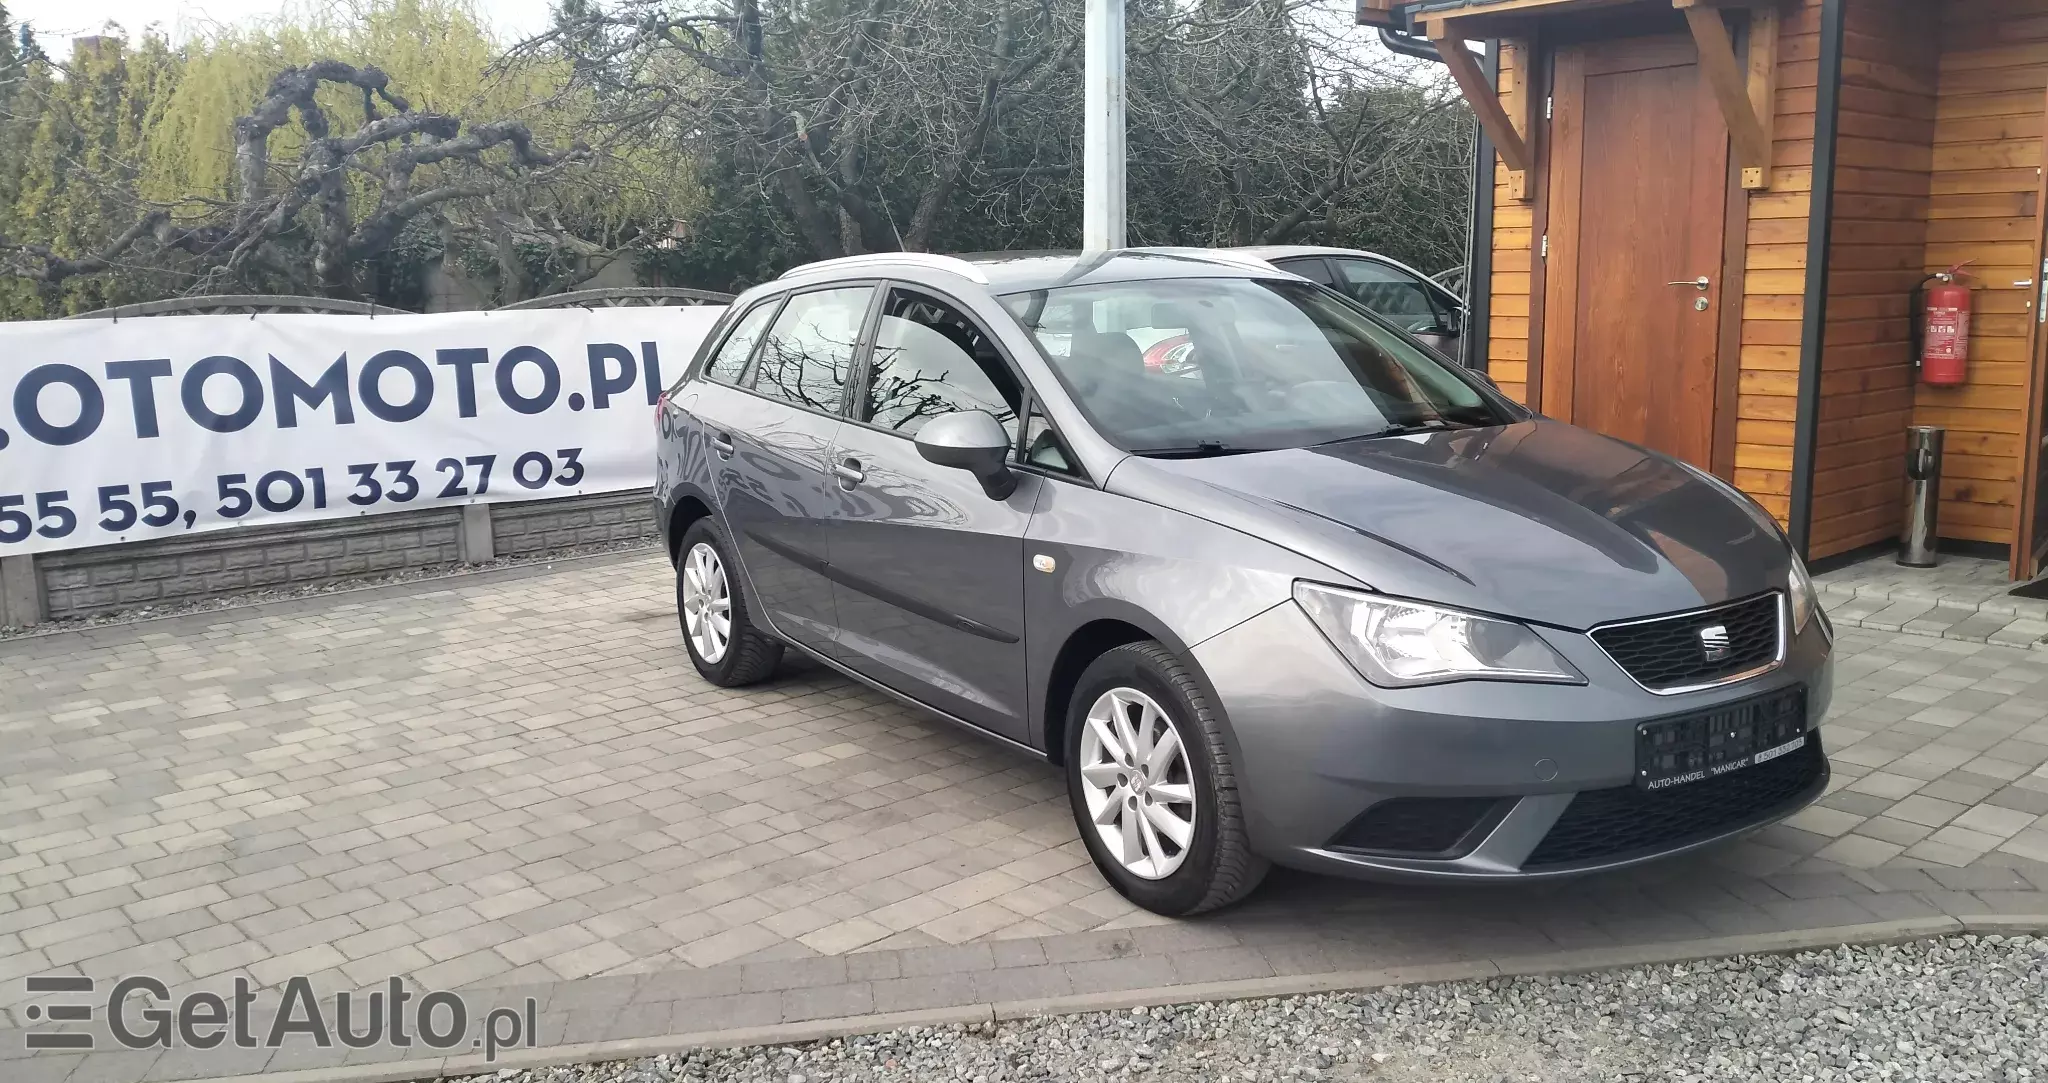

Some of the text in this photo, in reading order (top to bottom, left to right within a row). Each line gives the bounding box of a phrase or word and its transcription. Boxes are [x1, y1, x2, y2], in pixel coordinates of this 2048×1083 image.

[0, 447, 585, 544] 55 55, 501 33 27 03
[1647, 770, 1706, 790] AUTO-HANDEL
